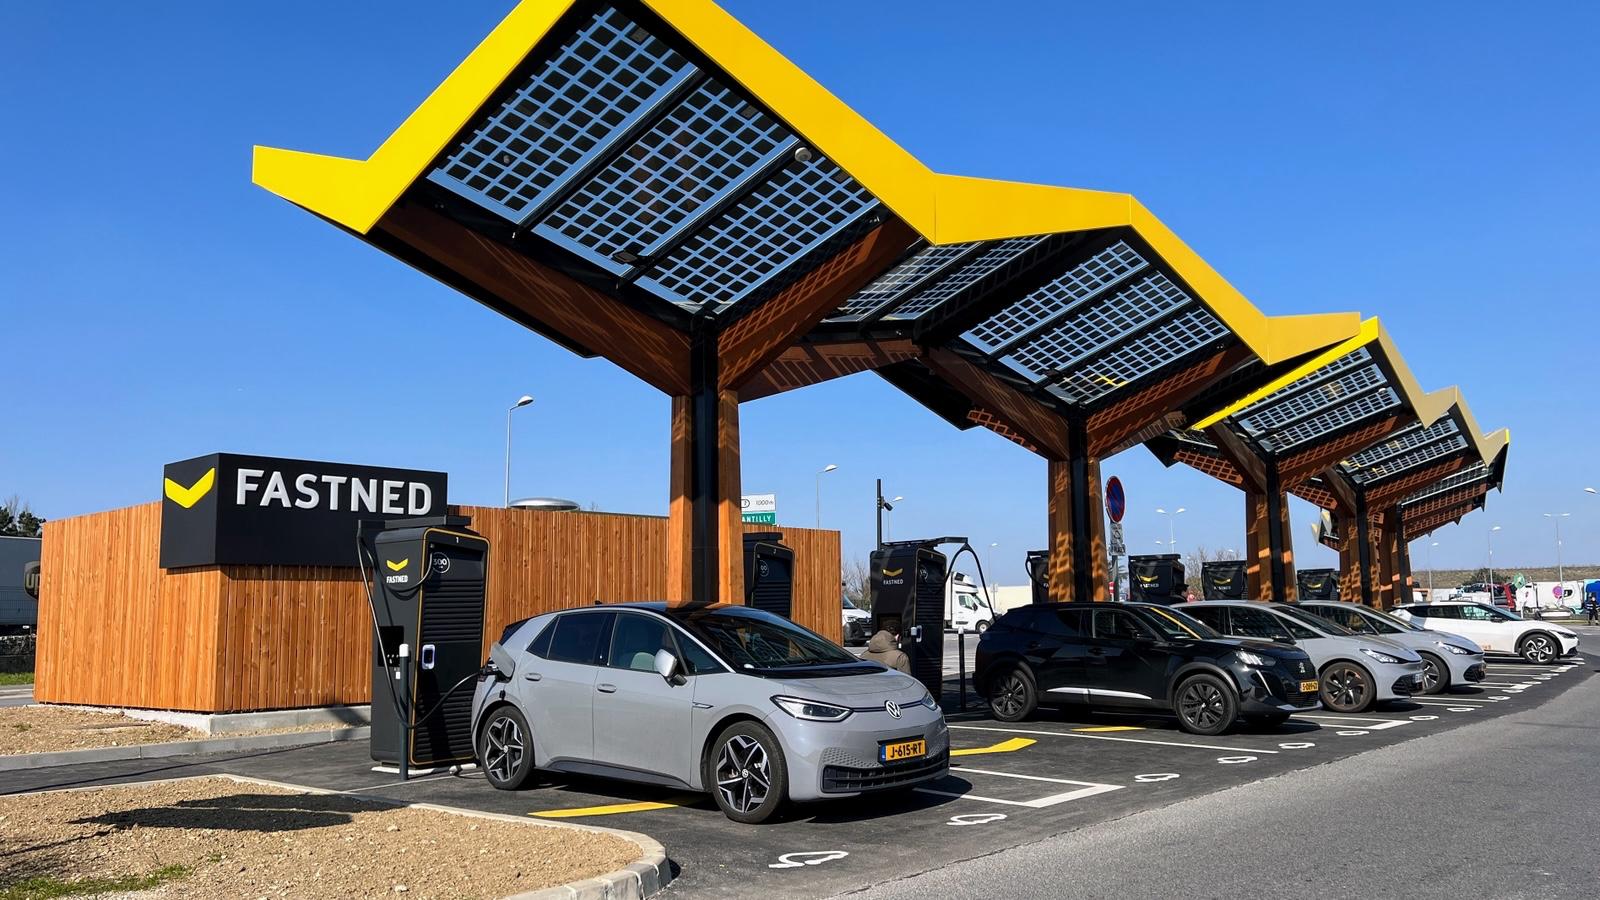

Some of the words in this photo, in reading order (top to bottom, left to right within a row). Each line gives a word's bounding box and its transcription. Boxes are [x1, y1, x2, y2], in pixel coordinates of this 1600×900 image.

[236, 468, 432, 515] FASTNED
[742, 515, 771, 523] ANTILLY
[386, 575, 408, 584] FASTNED
[890, 742, 921, 758] J-615-RT
